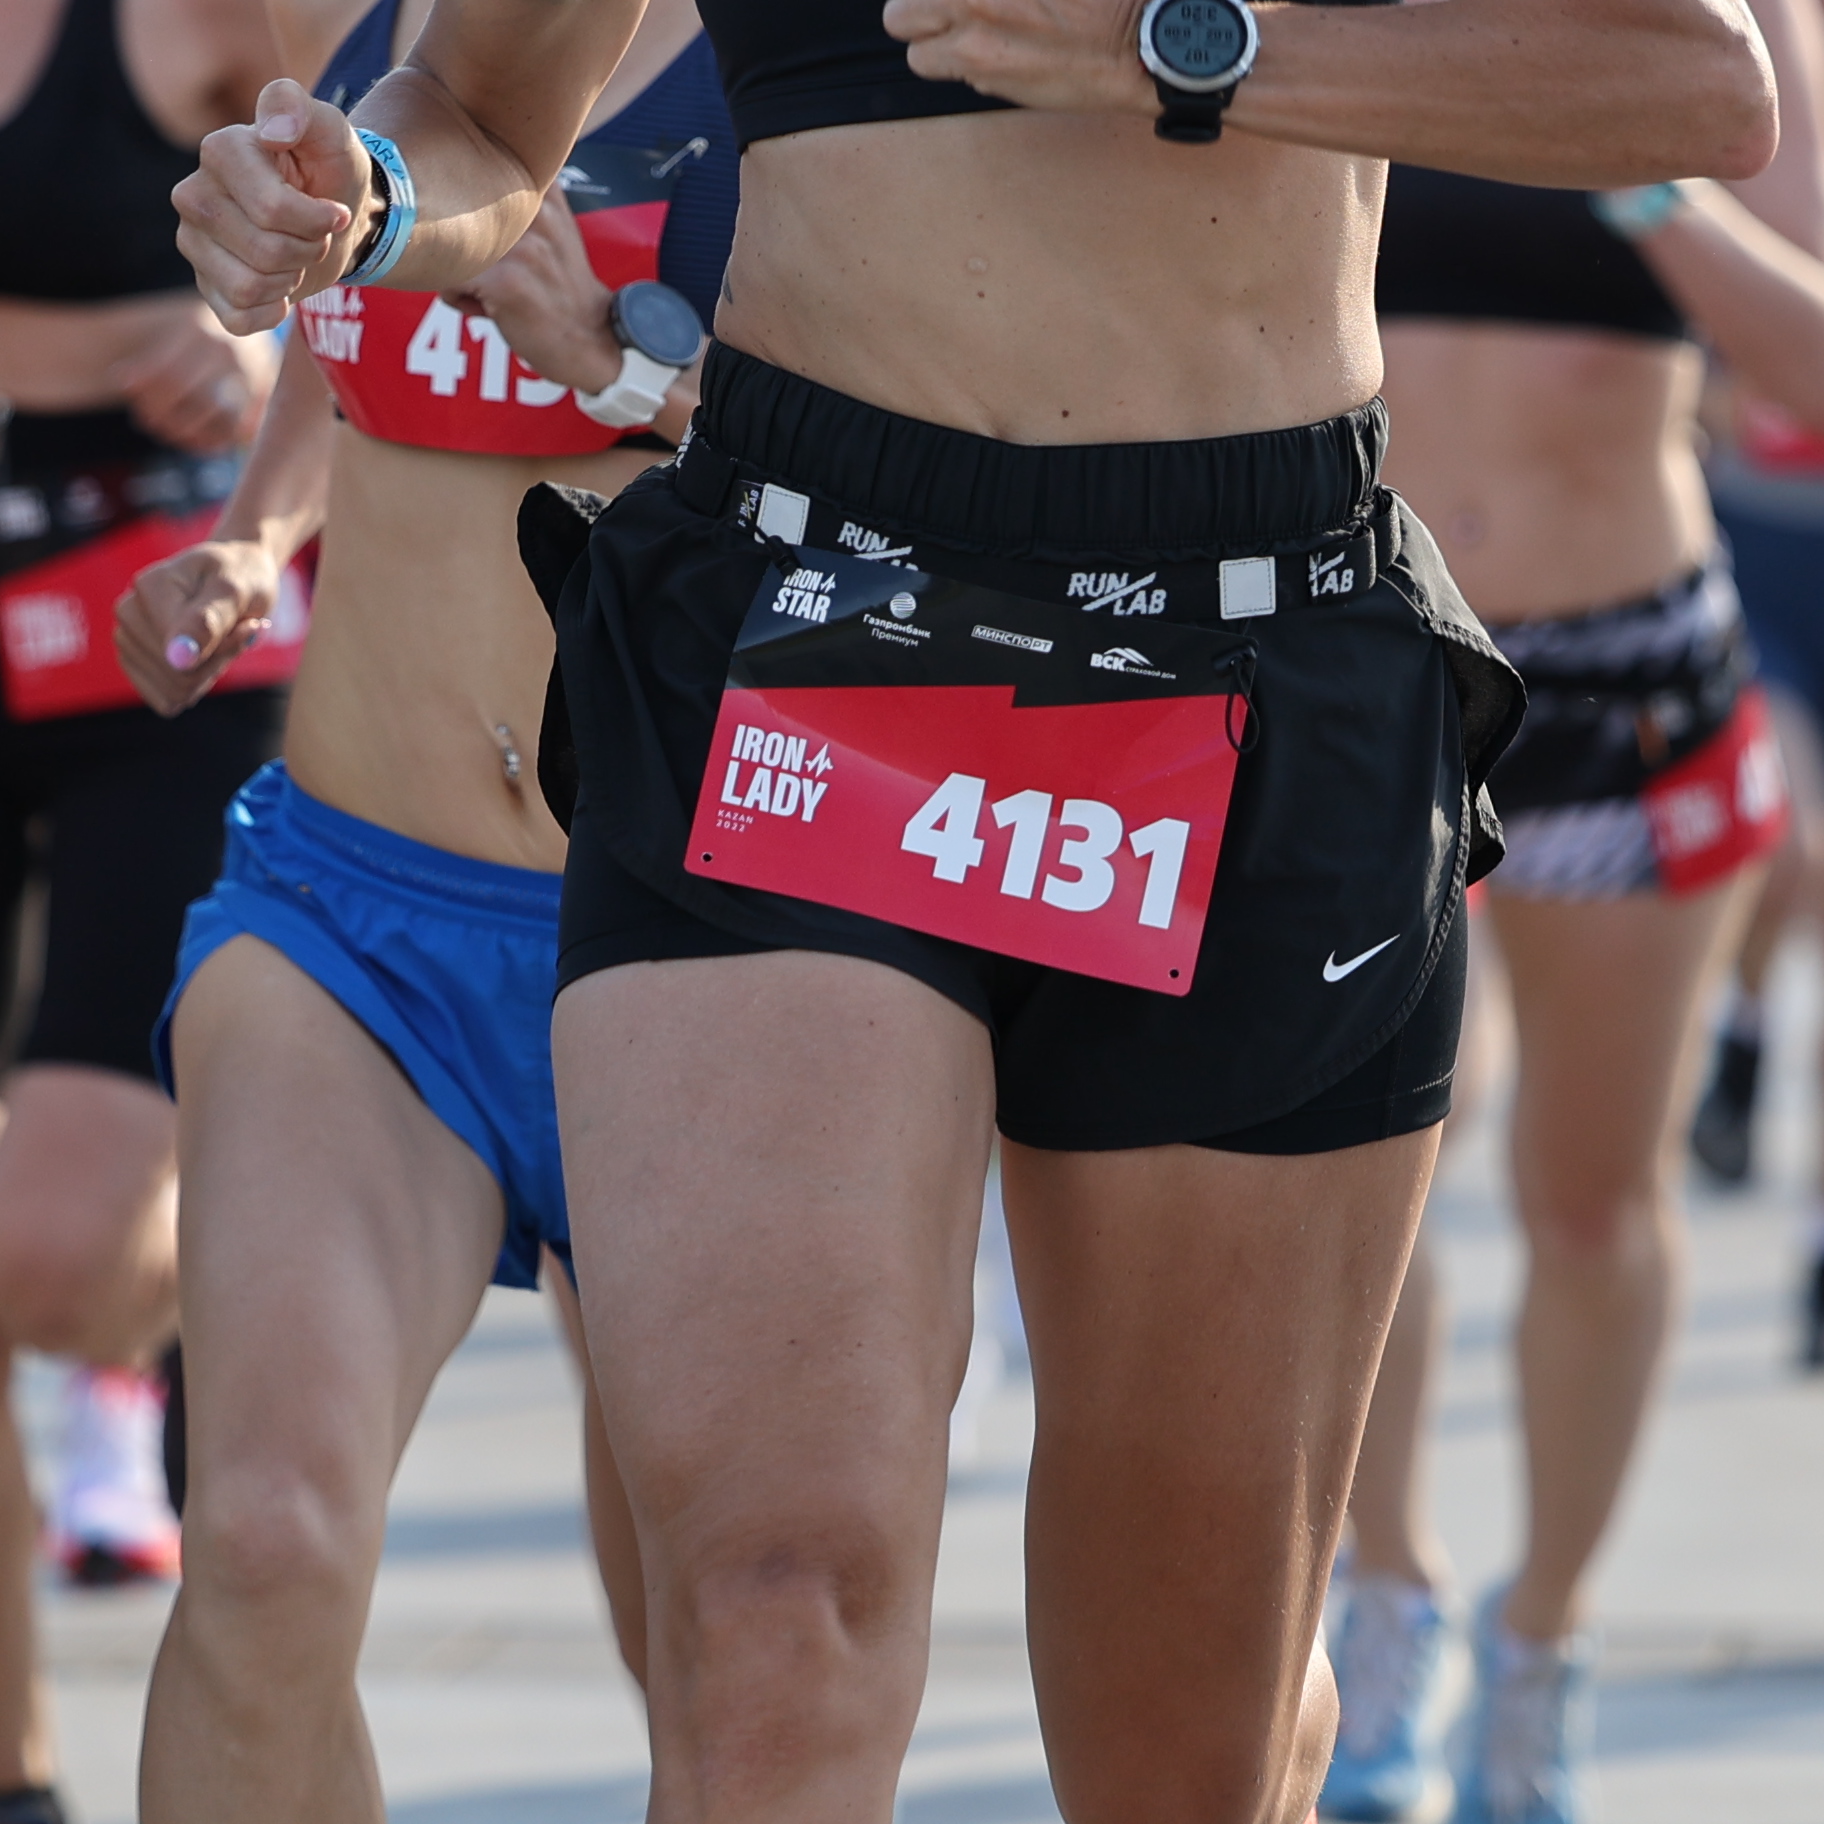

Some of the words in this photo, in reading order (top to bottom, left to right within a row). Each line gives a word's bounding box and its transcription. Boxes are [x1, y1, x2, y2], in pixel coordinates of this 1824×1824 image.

[1066, 572, 1129, 597] RUN
[772, 587, 831, 623] STAR
[1113, 589, 1167, 616] LAB
[863, 613, 931, 639] Газпромбанк
[871, 628, 919, 647] Премиум
[974, 627, 1050, 651] МИНСПОРТ
[1090, 653, 1126, 671] ВСК
[730, 723, 808, 773] IRON
[720, 760, 829, 823] LADY
[716, 819, 746, 833] 2022
[717, 809, 754, 824] KAZAN
[900, 772, 1191, 930] 4131
